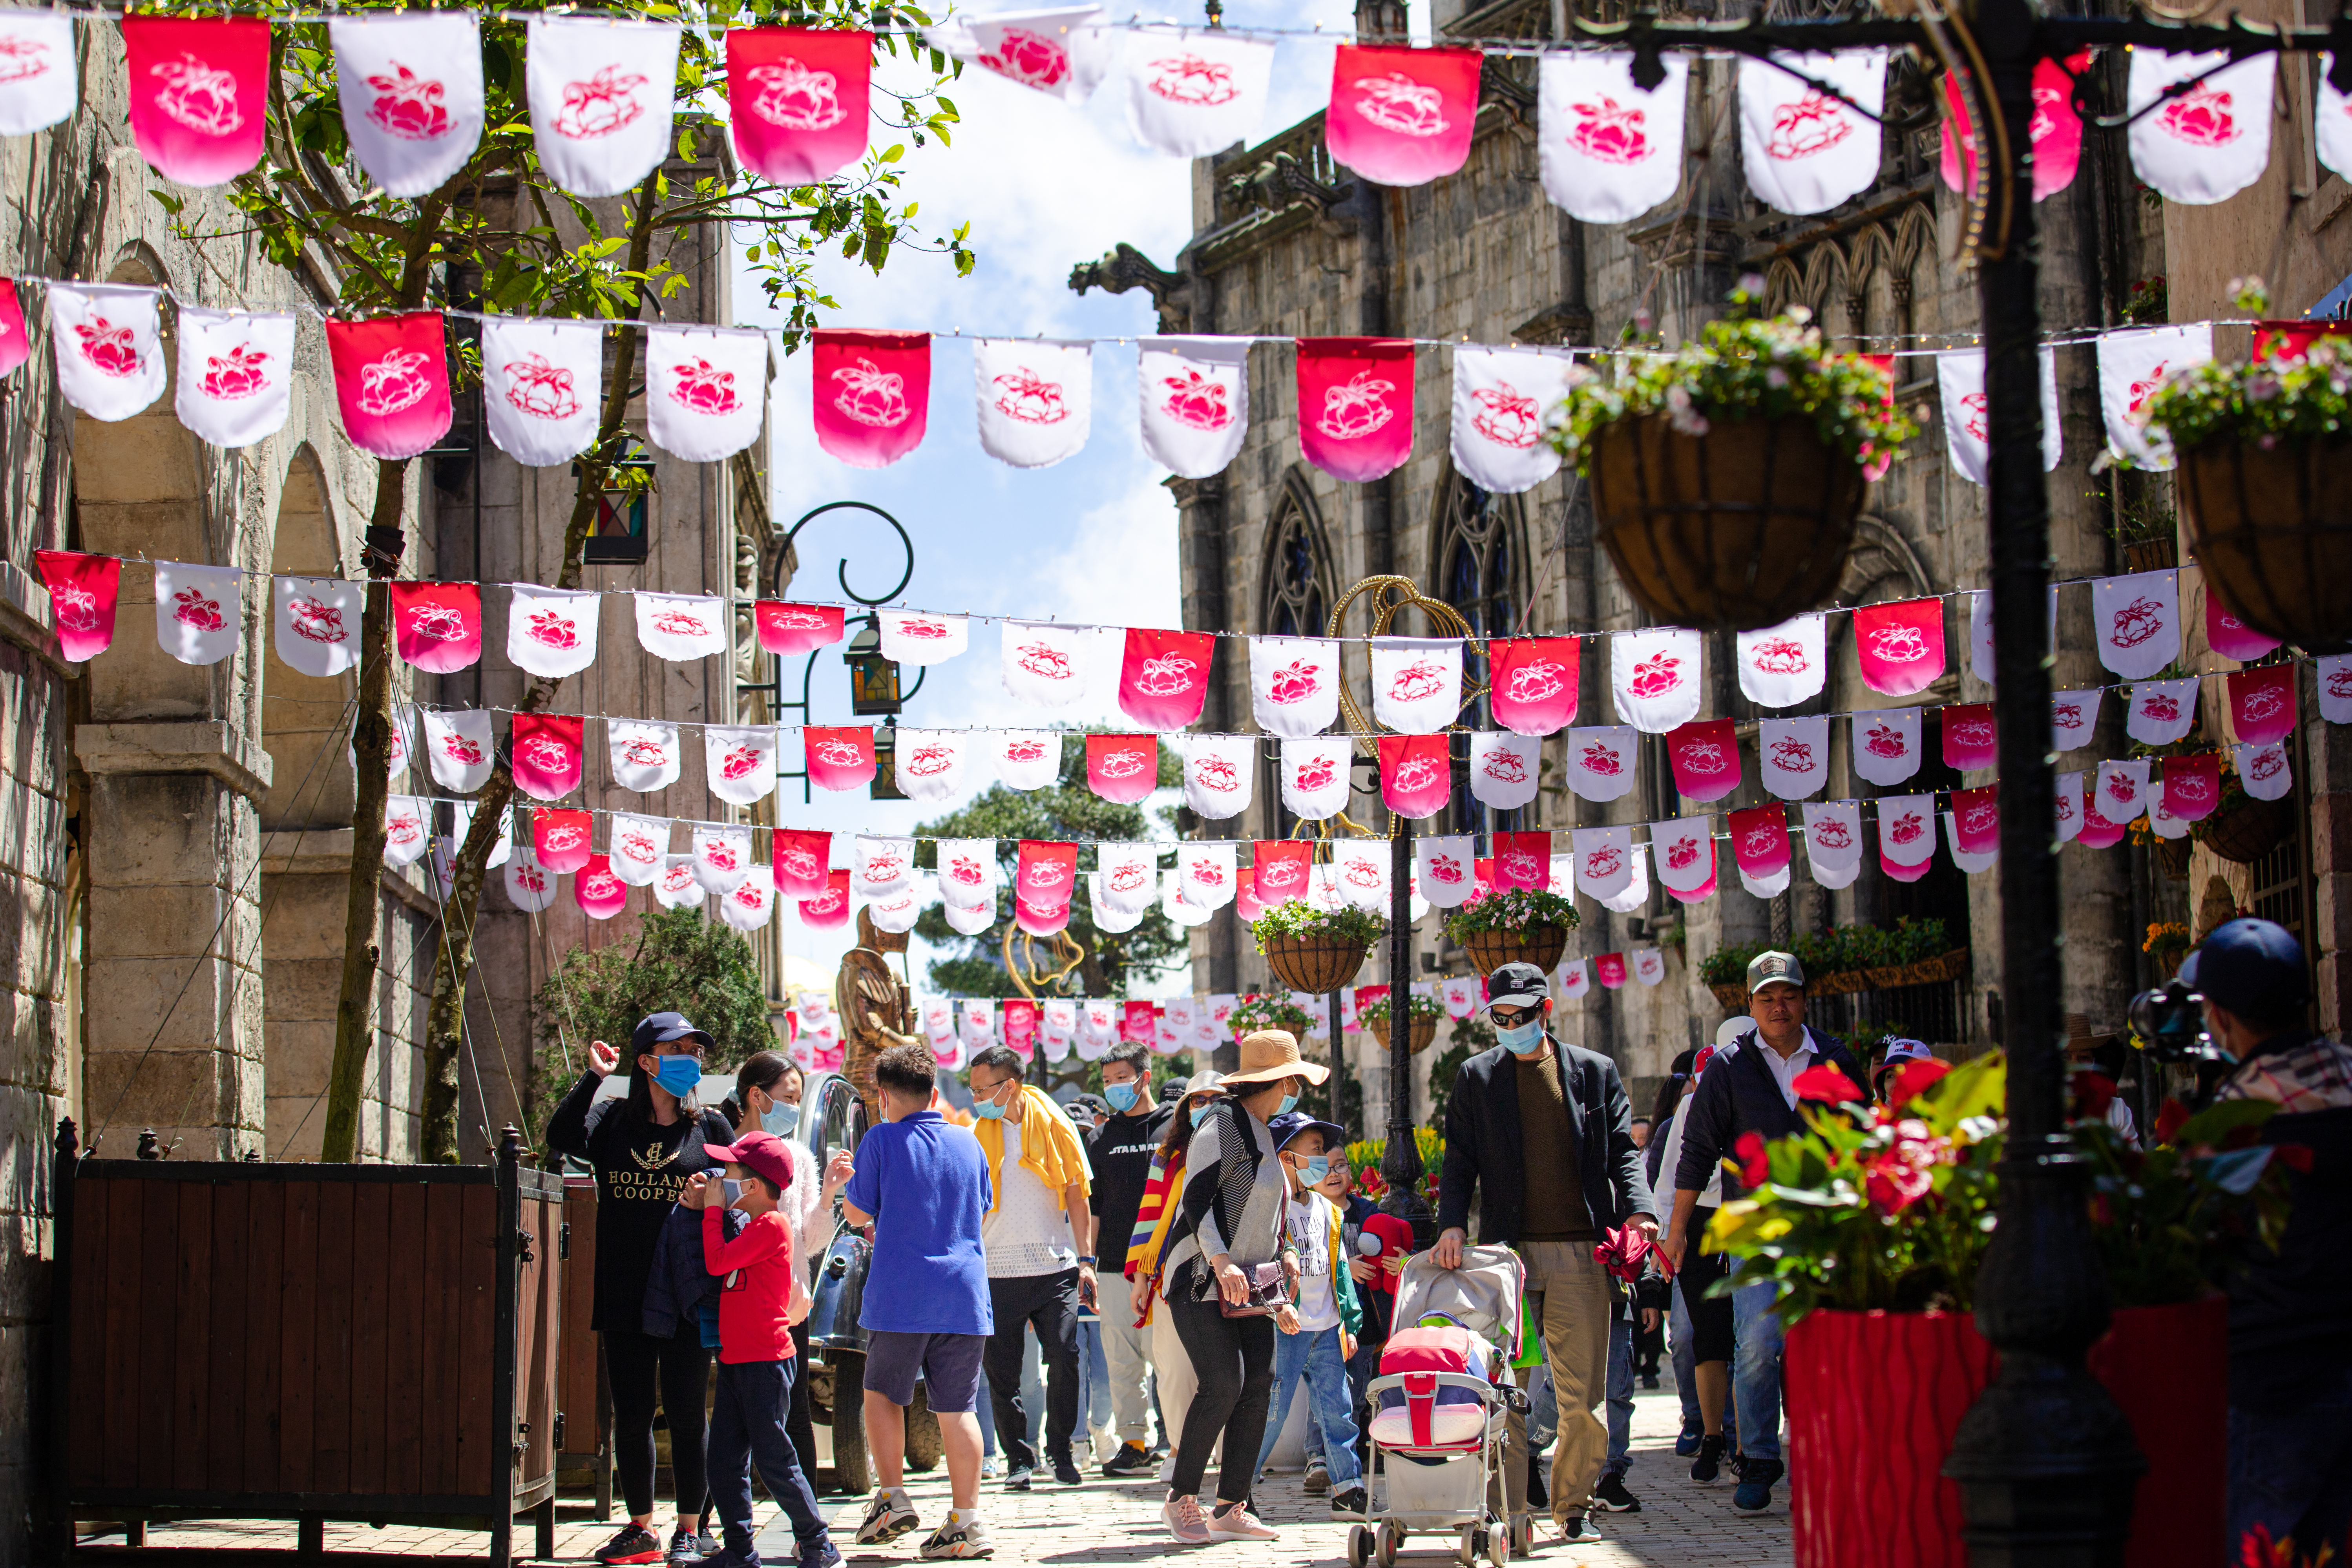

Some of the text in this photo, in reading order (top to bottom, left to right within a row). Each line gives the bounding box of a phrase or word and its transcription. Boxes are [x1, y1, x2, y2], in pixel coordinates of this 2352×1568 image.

[1108, 1142, 1161, 1155] STAR WAR
[609, 1171, 686, 1189] HOLLAN
